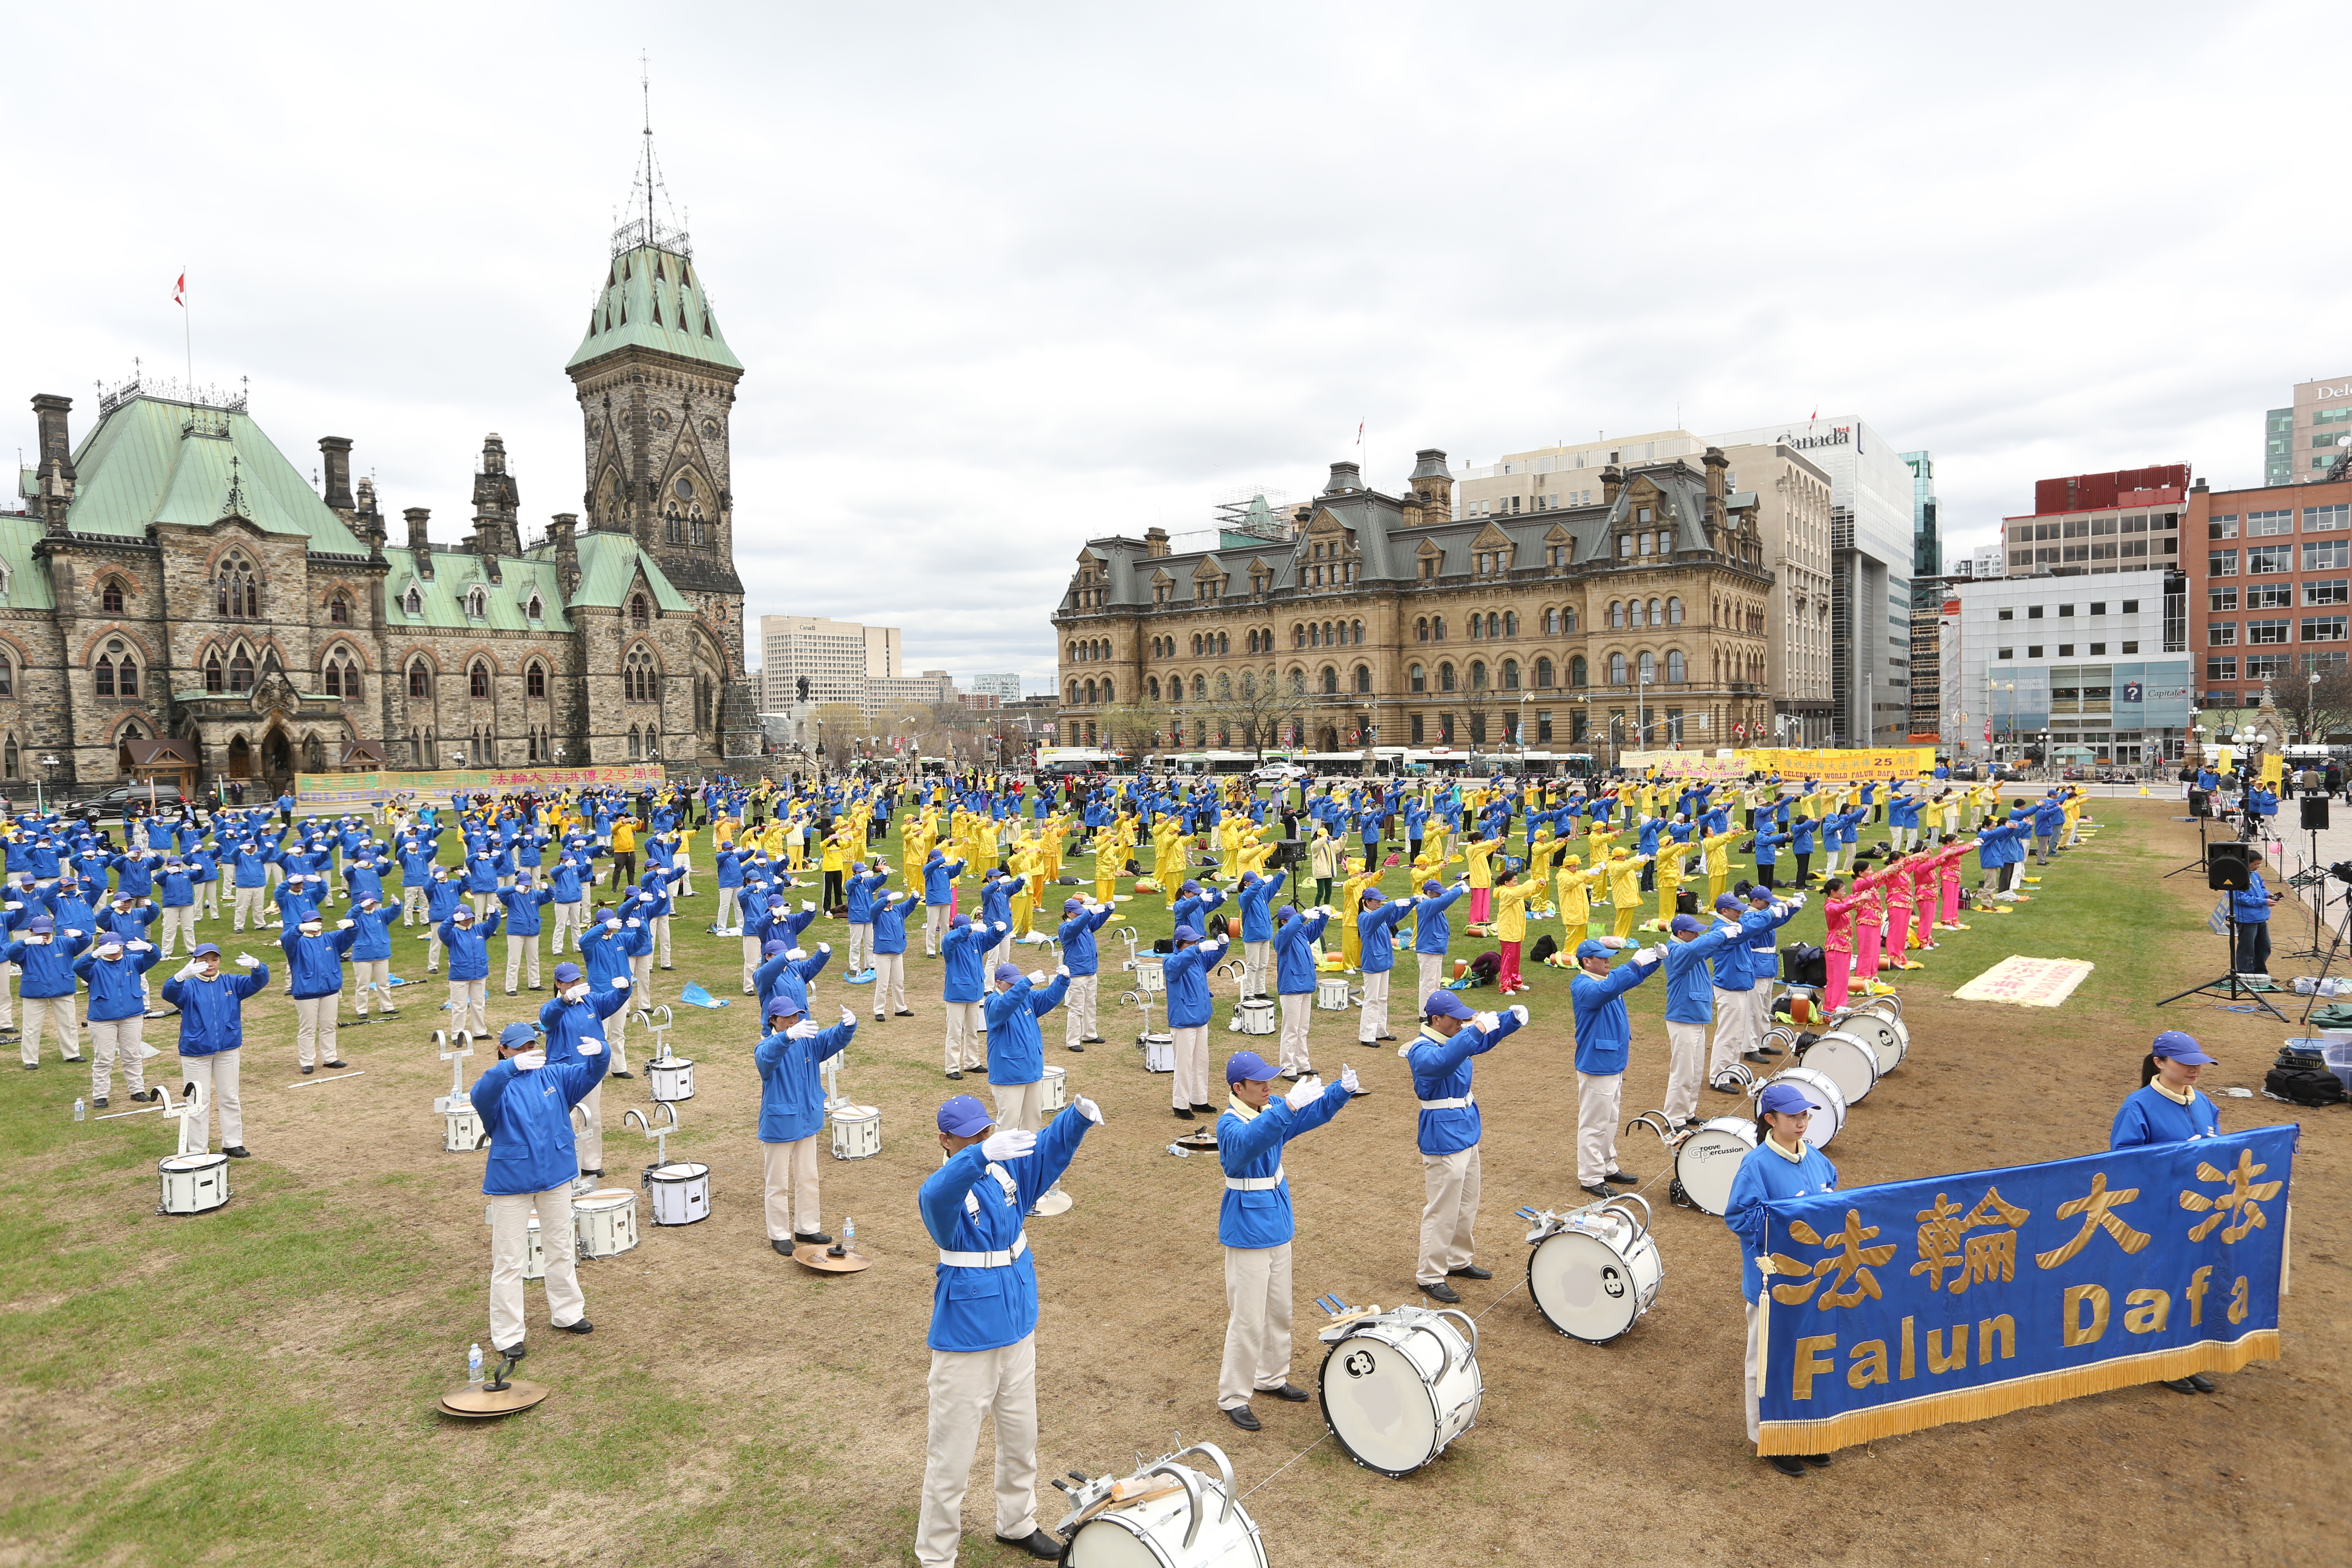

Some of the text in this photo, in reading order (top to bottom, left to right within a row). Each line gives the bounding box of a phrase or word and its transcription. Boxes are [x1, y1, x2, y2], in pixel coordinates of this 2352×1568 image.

[1777, 428, 1849, 449] Canada
[2148, 690, 2181, 698] Capitale
[1662, 758, 1746, 771] 法轮大法好
[1784, 770, 1821, 778] CELEBRATE
[1851, 770, 1873, 779] FALUN
[1688, 1144, 1721, 1159] Groove
[1700, 1146, 1744, 1163] Percussion
[1769, 1149, 2283, 1312] 法輪大法
[811, 1253, 830, 1263] SABIAN
[1793, 1265, 2248, 1401] Falun Dafa
